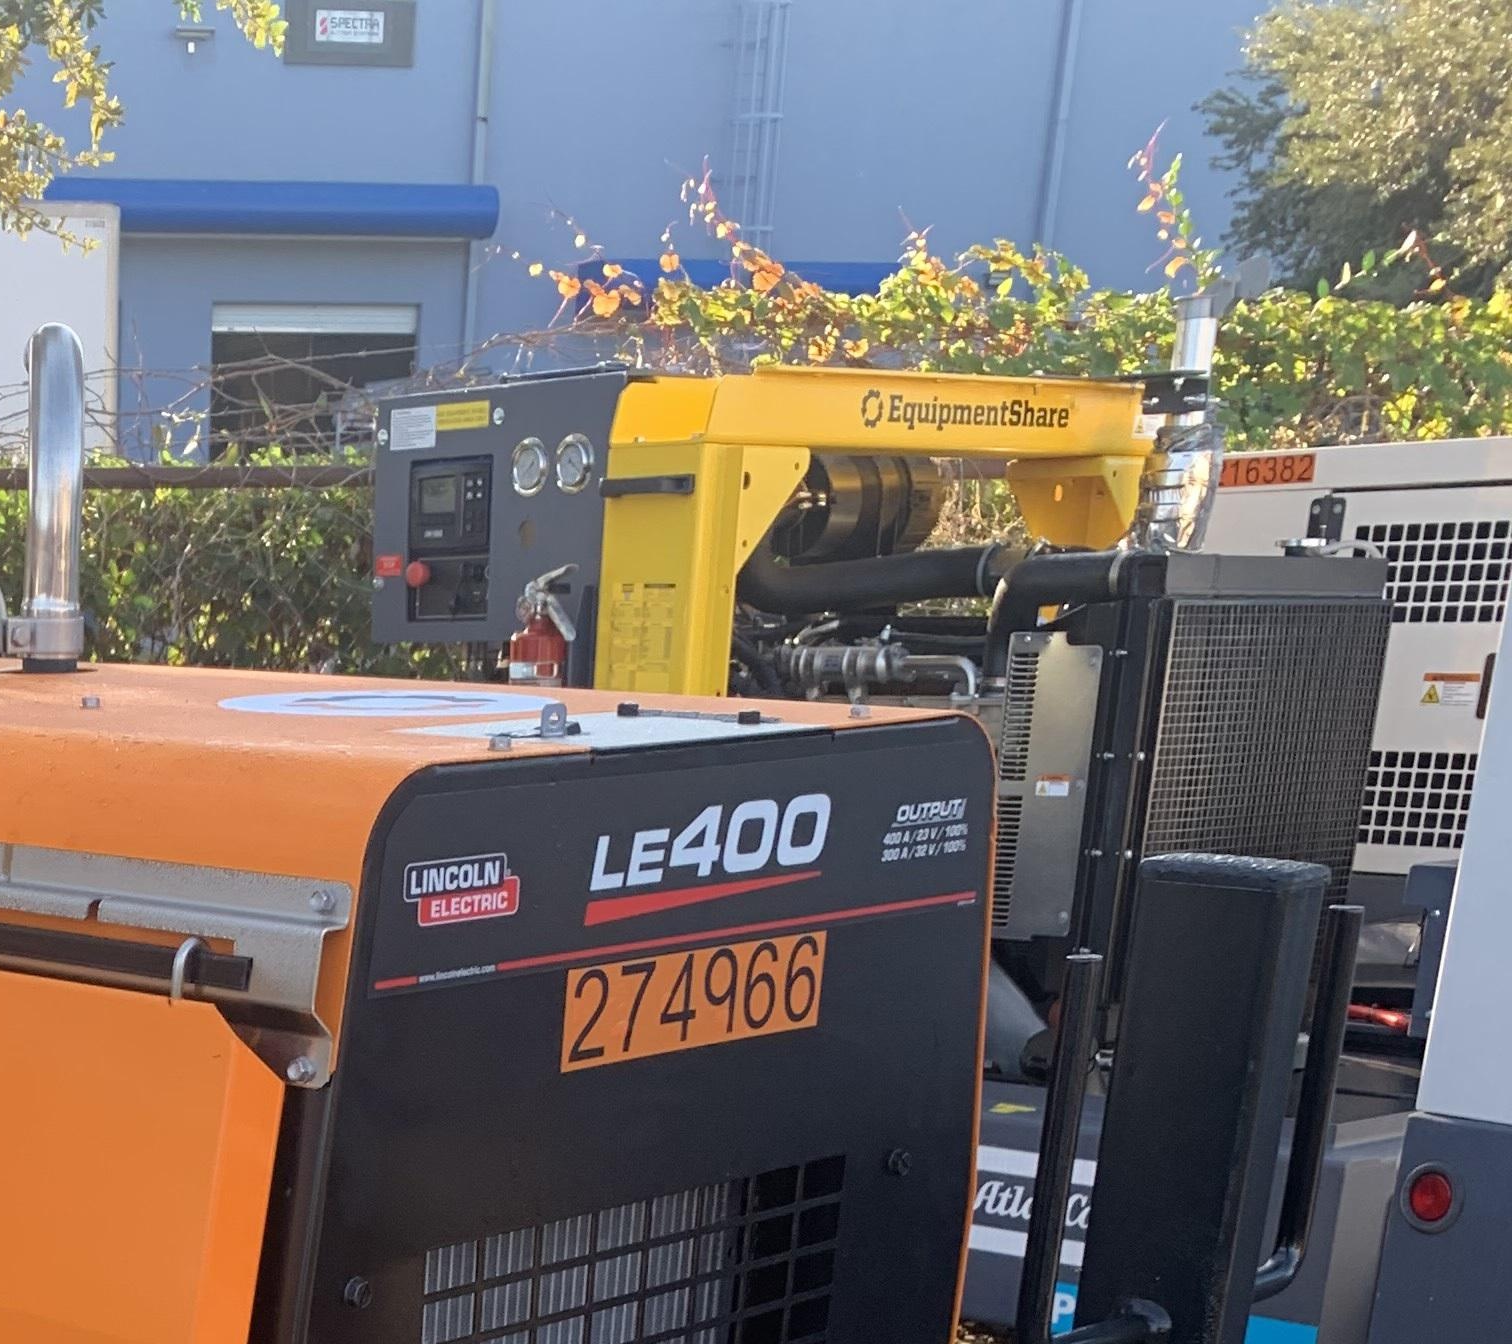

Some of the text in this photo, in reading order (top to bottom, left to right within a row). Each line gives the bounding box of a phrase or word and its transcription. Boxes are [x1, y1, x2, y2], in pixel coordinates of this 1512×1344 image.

[888, 395, 1070, 431] EquipmentShare
[896, 798, 963, 822] OUTPUT
[590, 793, 831, 892] LE400
[410, 860, 500, 896] LINCOLN
[430, 891, 508, 919] ELECTRIC
[568, 935, 822, 1064] 274966
